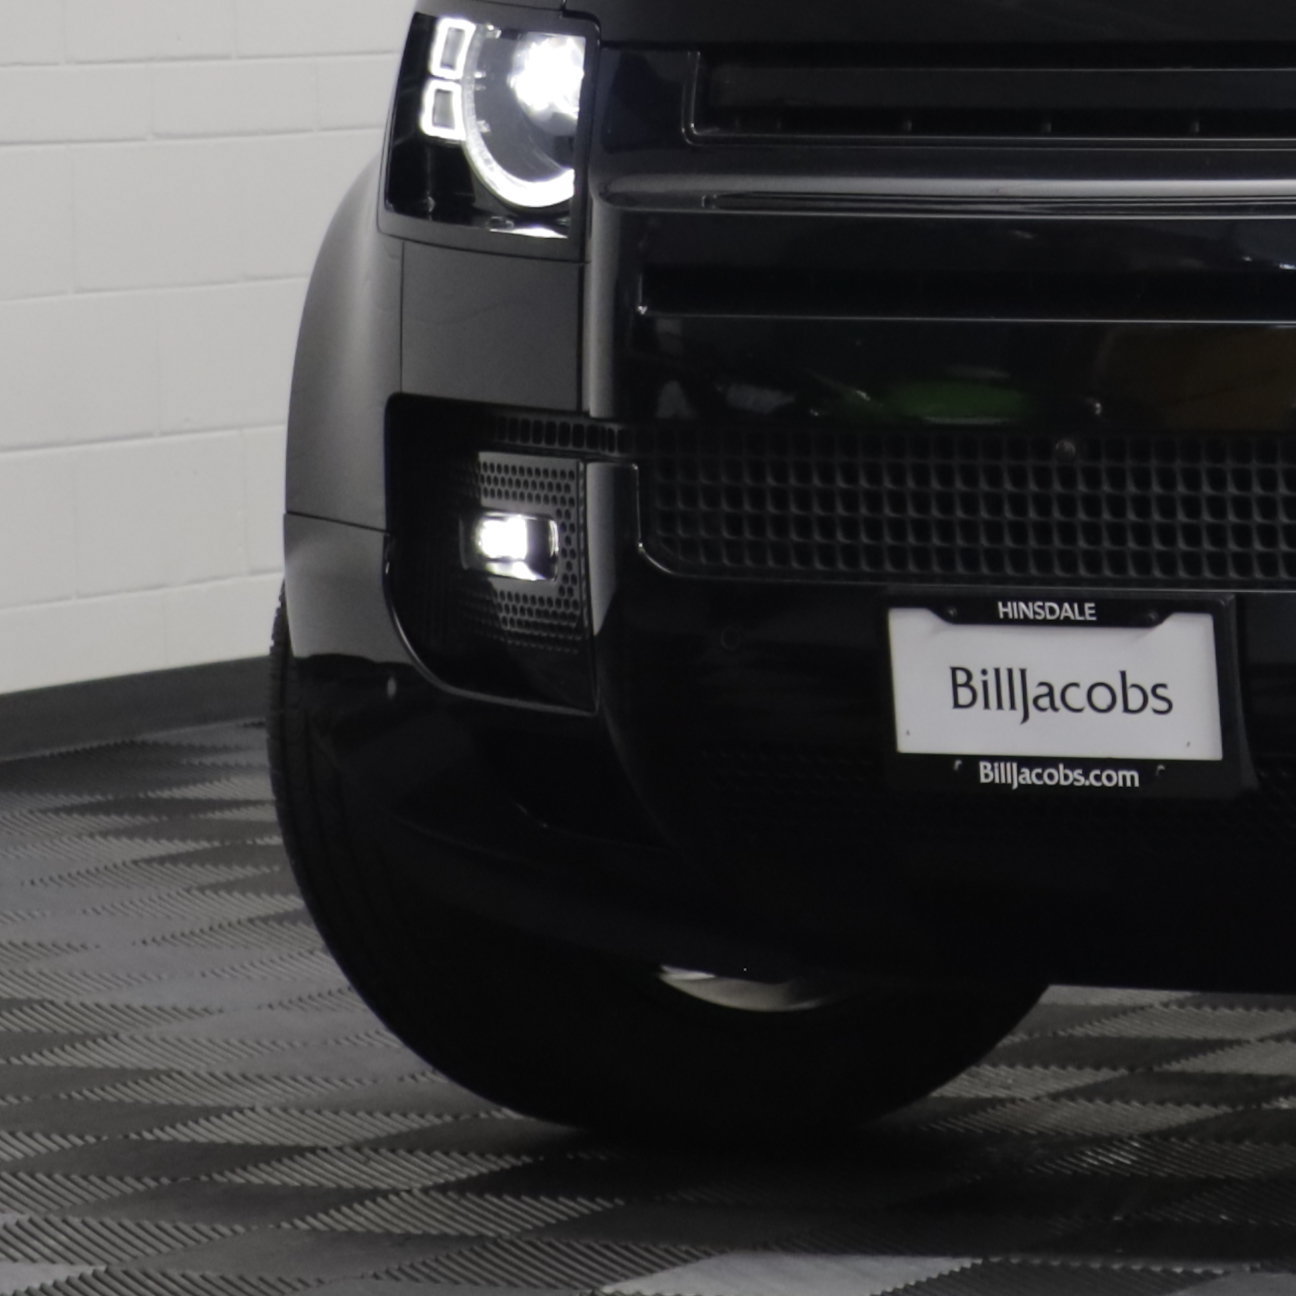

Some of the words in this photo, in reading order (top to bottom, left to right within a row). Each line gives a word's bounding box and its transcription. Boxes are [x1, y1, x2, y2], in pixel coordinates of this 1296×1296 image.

[997, 601, 1098, 622] HINSDALE
[949, 665, 1174, 725] BillJacobs
[978, 760, 1140, 790] BillJacobs.com
